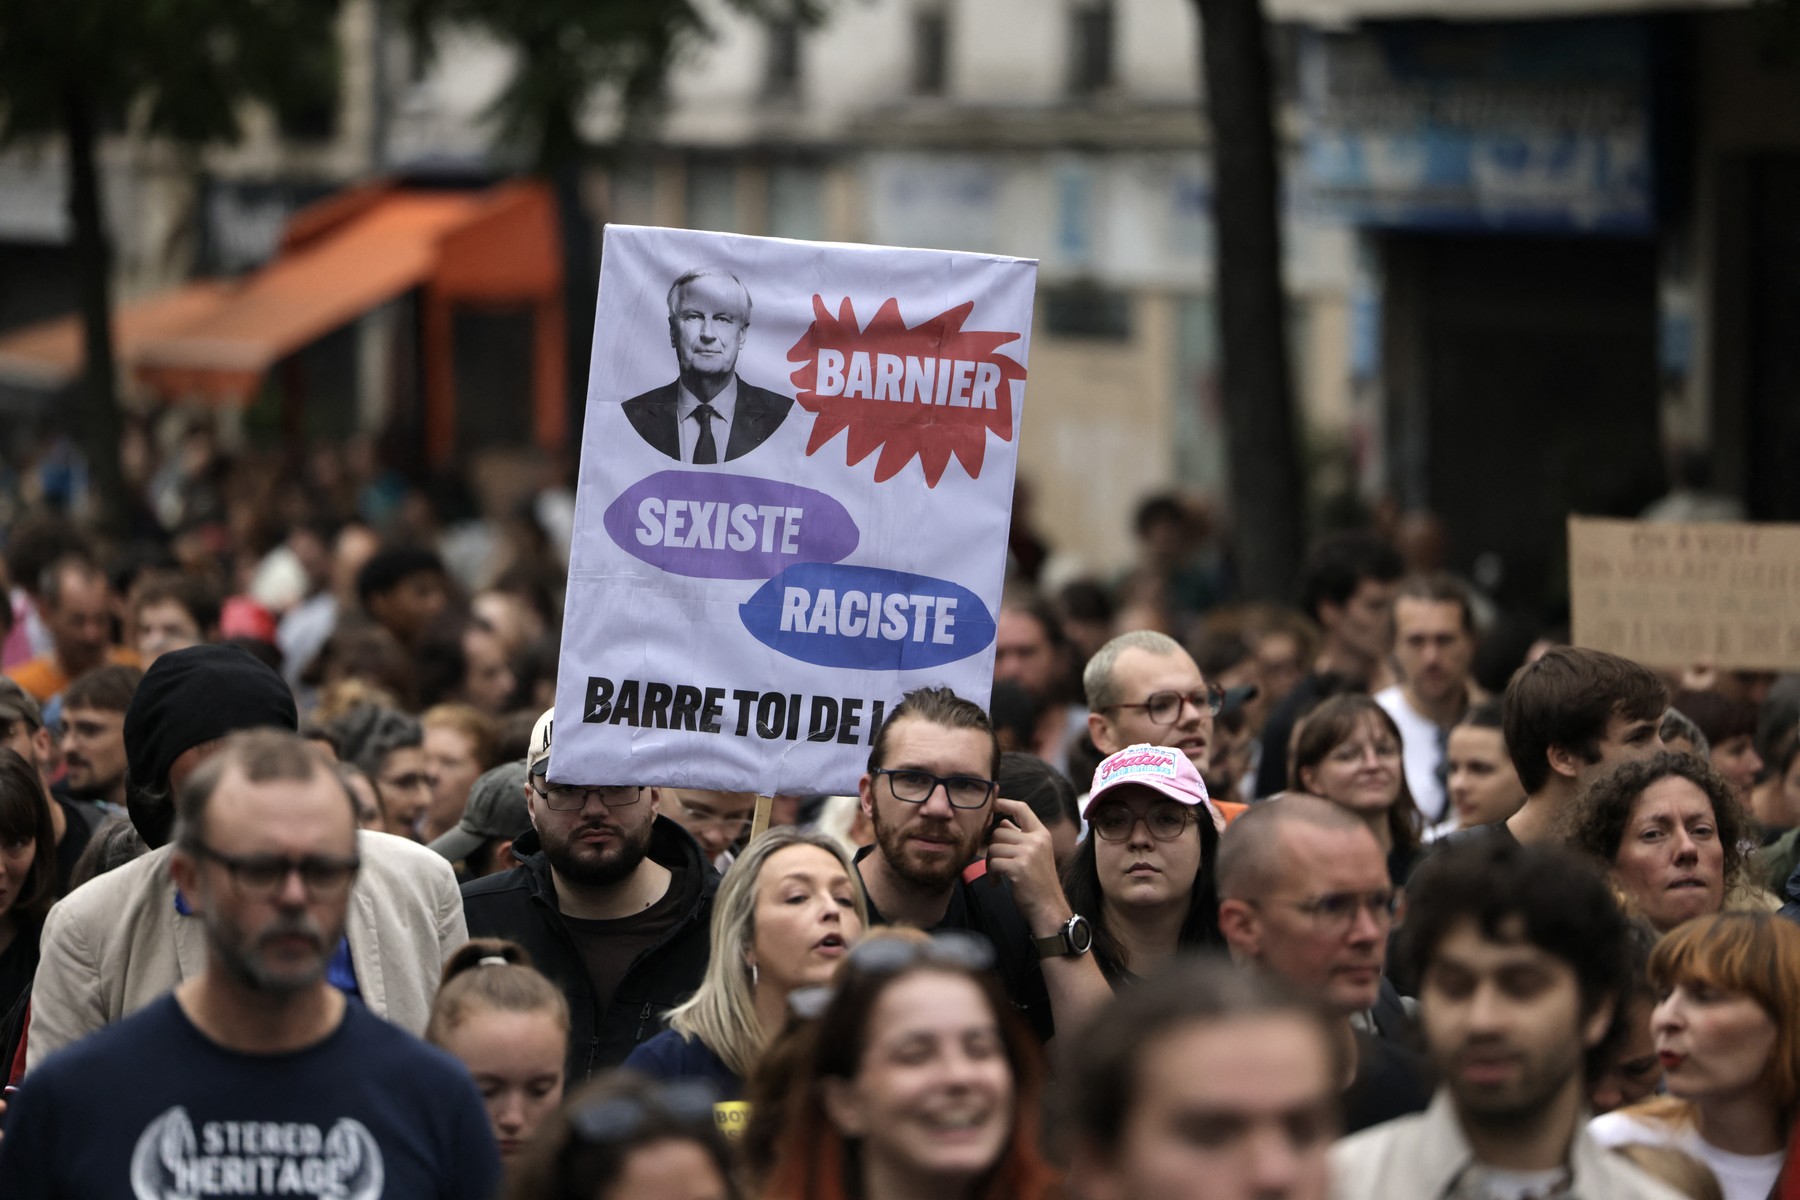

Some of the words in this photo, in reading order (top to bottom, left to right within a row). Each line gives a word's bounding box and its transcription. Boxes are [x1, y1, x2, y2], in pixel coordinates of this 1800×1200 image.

[815, 349, 1001, 410] BARNIER
[635, 498, 804, 555] SEXISTE
[779, 586, 959, 645] RACISTE
[582, 676, 727, 734] BARRE
[733, 688, 802, 741] TOI
[804, 696, 864, 745] DE
[174, 1154, 349, 1197] HERITAGE
